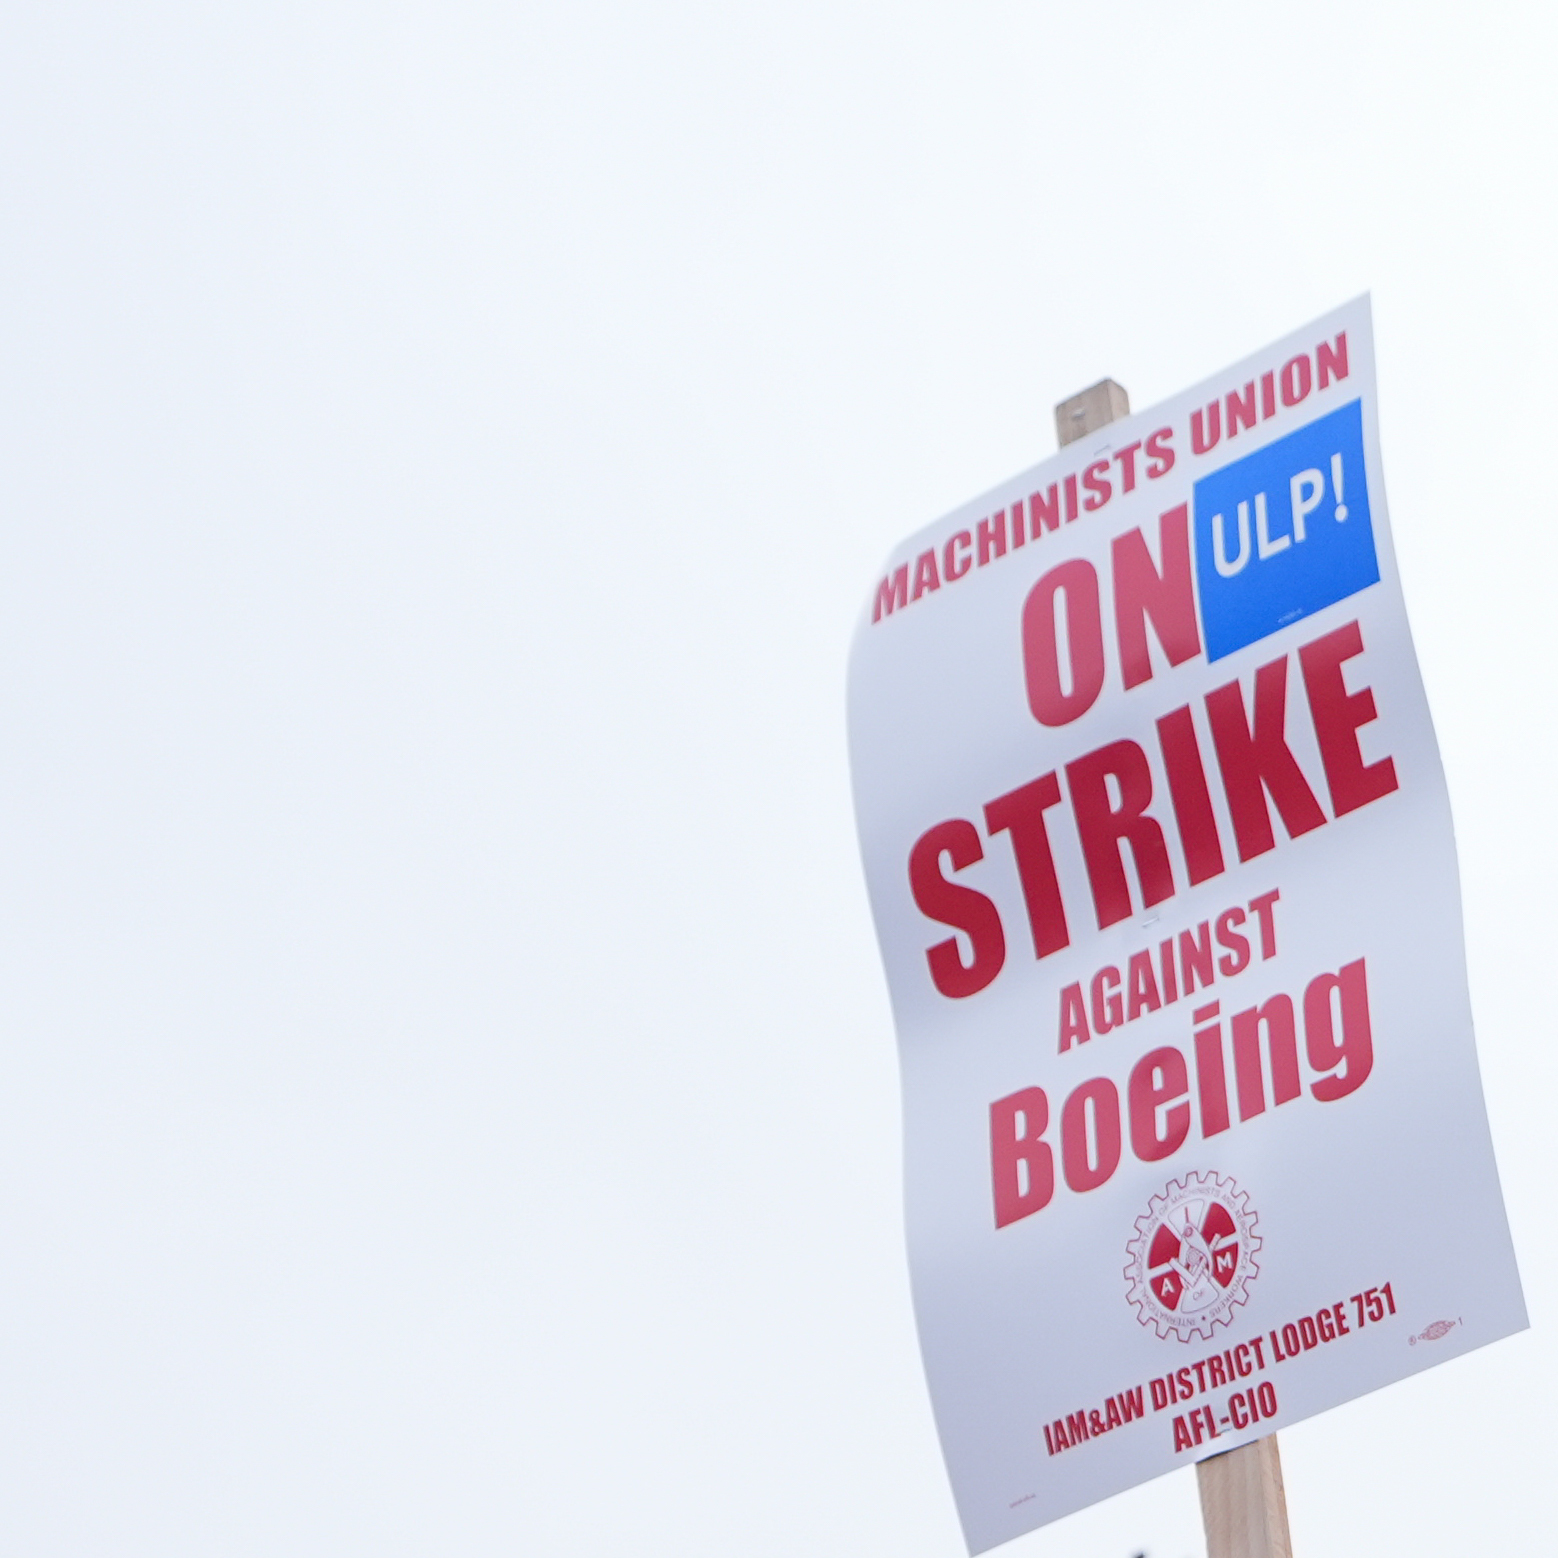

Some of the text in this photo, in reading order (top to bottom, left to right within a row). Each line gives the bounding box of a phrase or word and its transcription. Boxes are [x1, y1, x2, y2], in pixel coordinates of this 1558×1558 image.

[872, 331, 1350, 624] MACHINISTS UNION
[1211, 453, 1348, 579] ULP!
[1021, 501, 1202, 728] ON
[908, 619, 1399, 999] STRIKE
[1057, 890, 1282, 1055] AGAINST
[989, 957, 1374, 1230] Boeing
[1042, 1385, 1144, 1457] IAM&AW
[1150, 1337, 1266, 1411] DISTRICT
[1271, 1303, 1349, 1363] LODGE
[1351, 1283, 1396, 1328] 751
[1172, 1380, 1279, 1454] AFL-CIO
